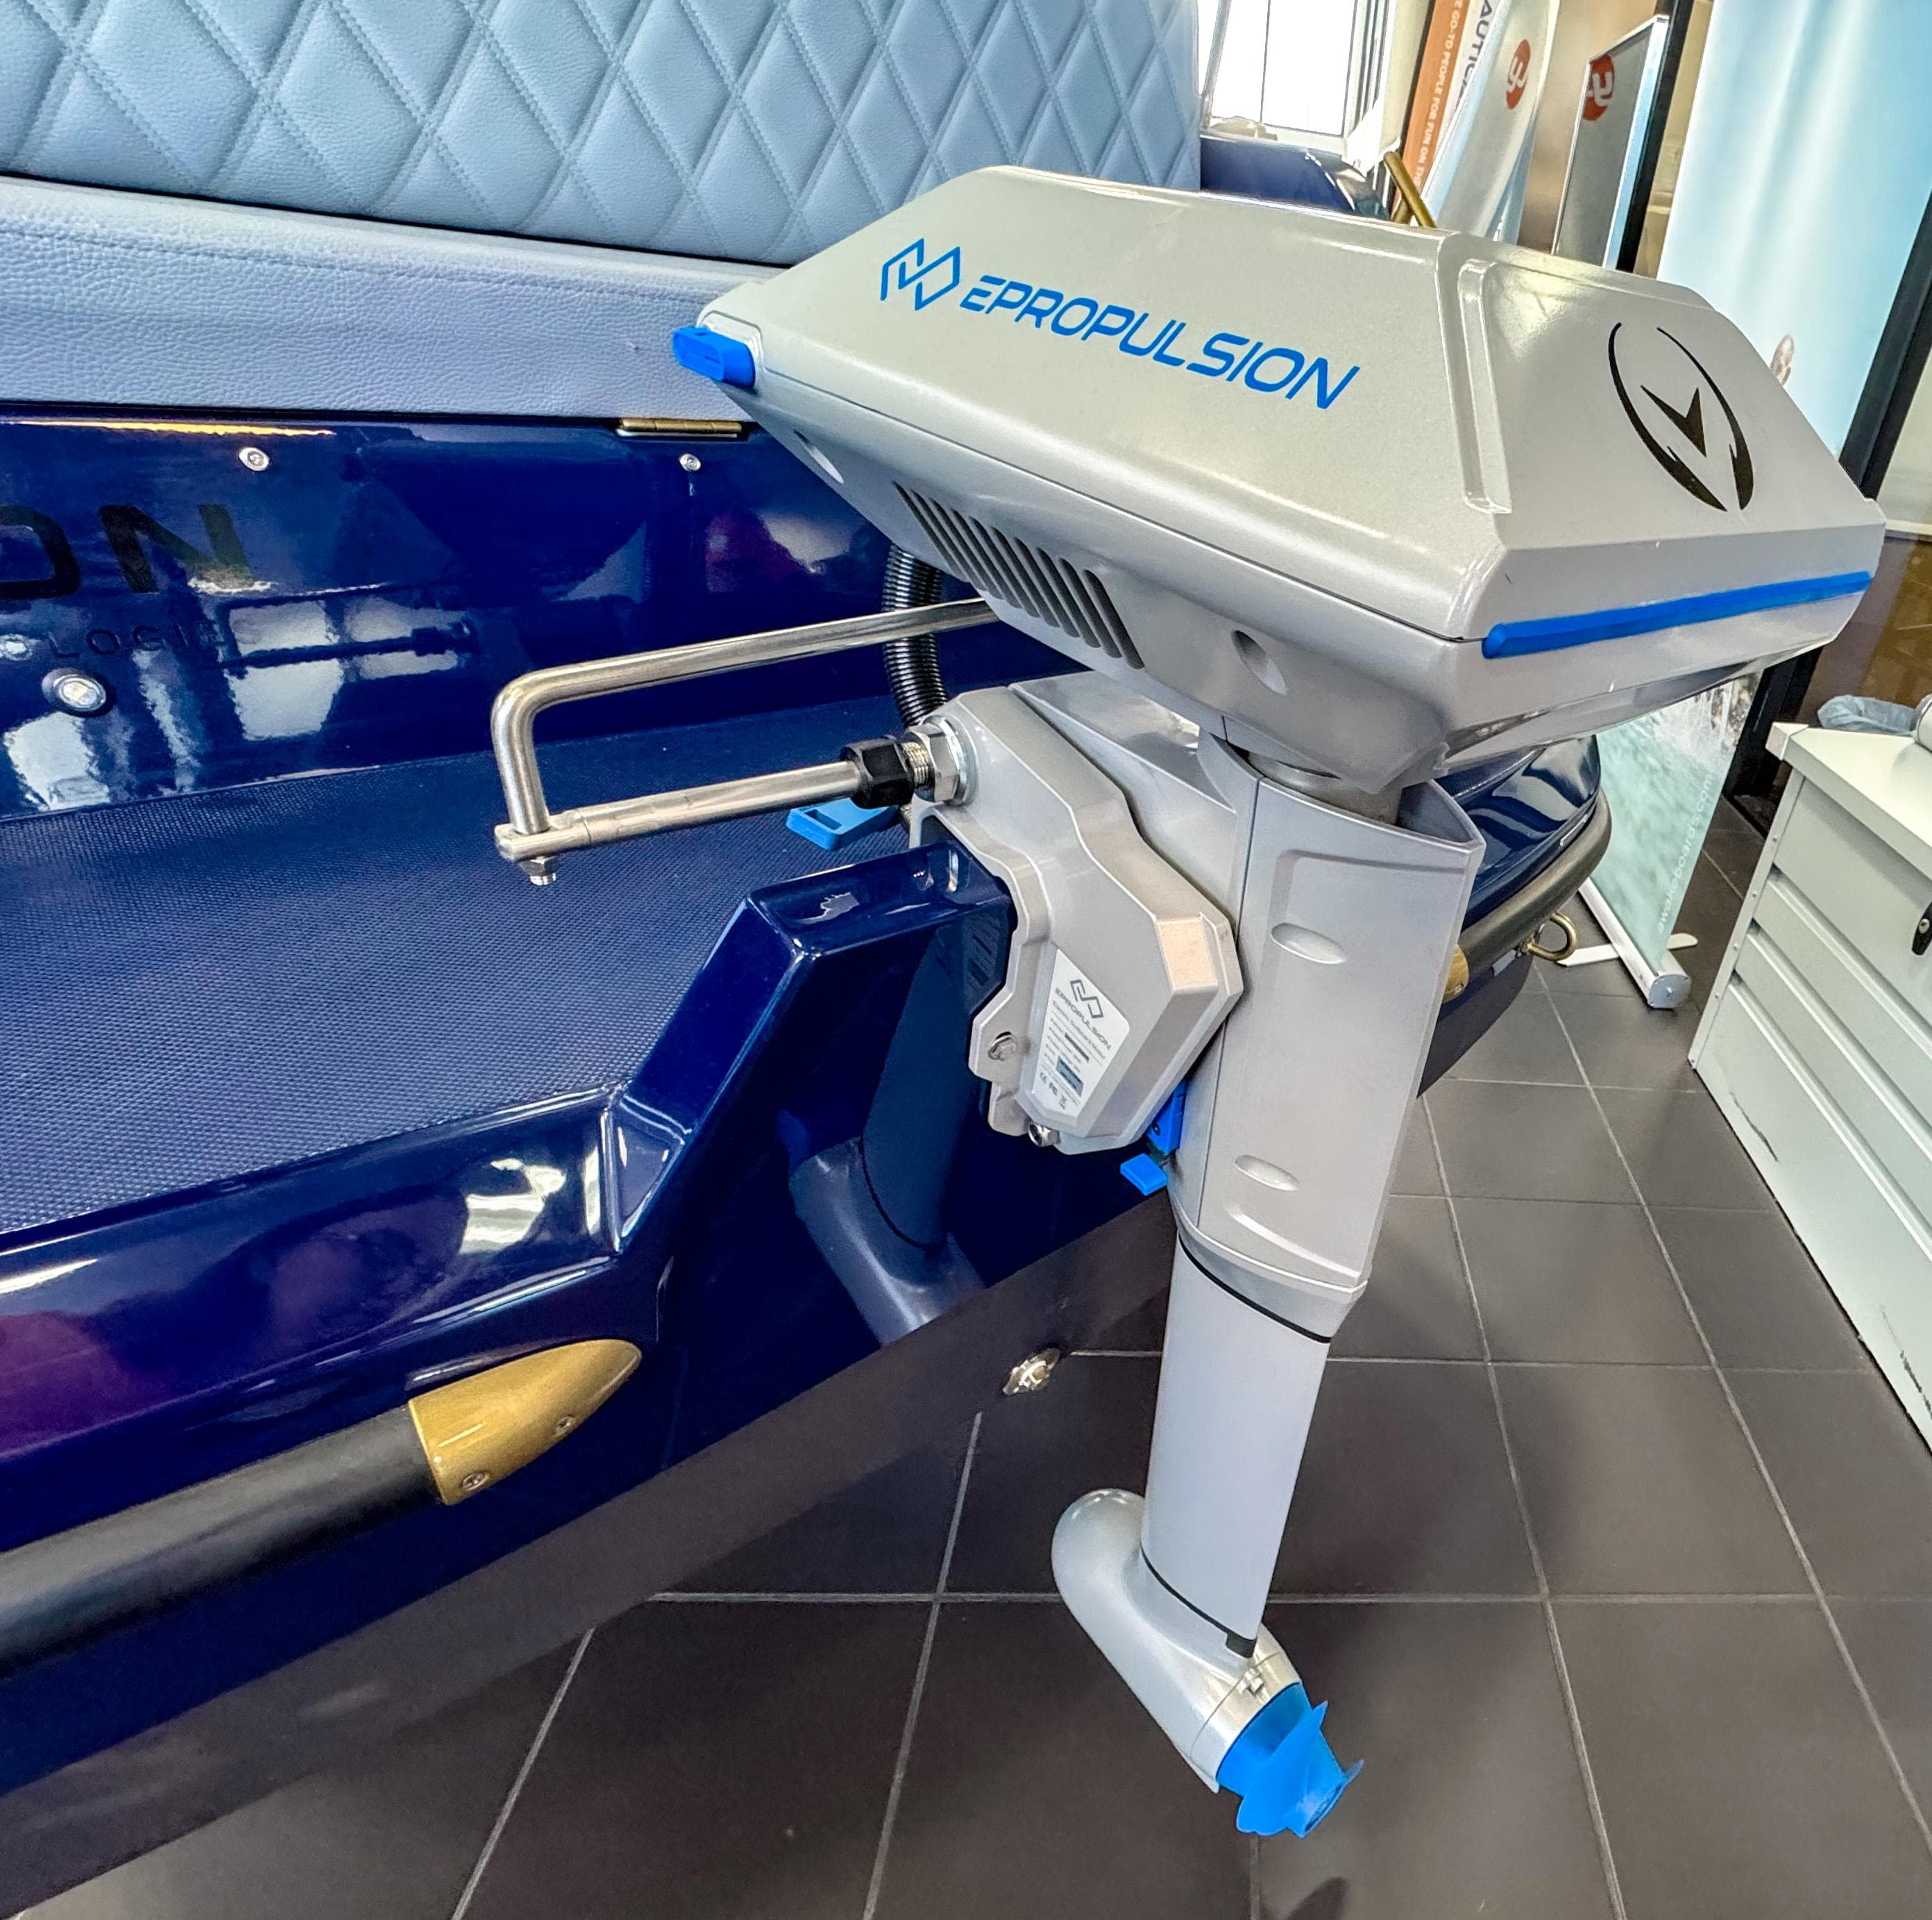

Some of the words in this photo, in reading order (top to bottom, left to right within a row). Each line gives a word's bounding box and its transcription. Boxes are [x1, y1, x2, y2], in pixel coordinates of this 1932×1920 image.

[1444, 9, 1460, 50] GO-TO
[1434, 51, 1451, 95] PEOPLE
[1427, 96, 1441, 119] FOR
[1423, 121, 1435, 145] FUN
[1418, 146, 1429, 164] ON
[960, 275, 1359, 410] EPROPULSION
[1055, 987, 1111, 1050] EPROPULSION
